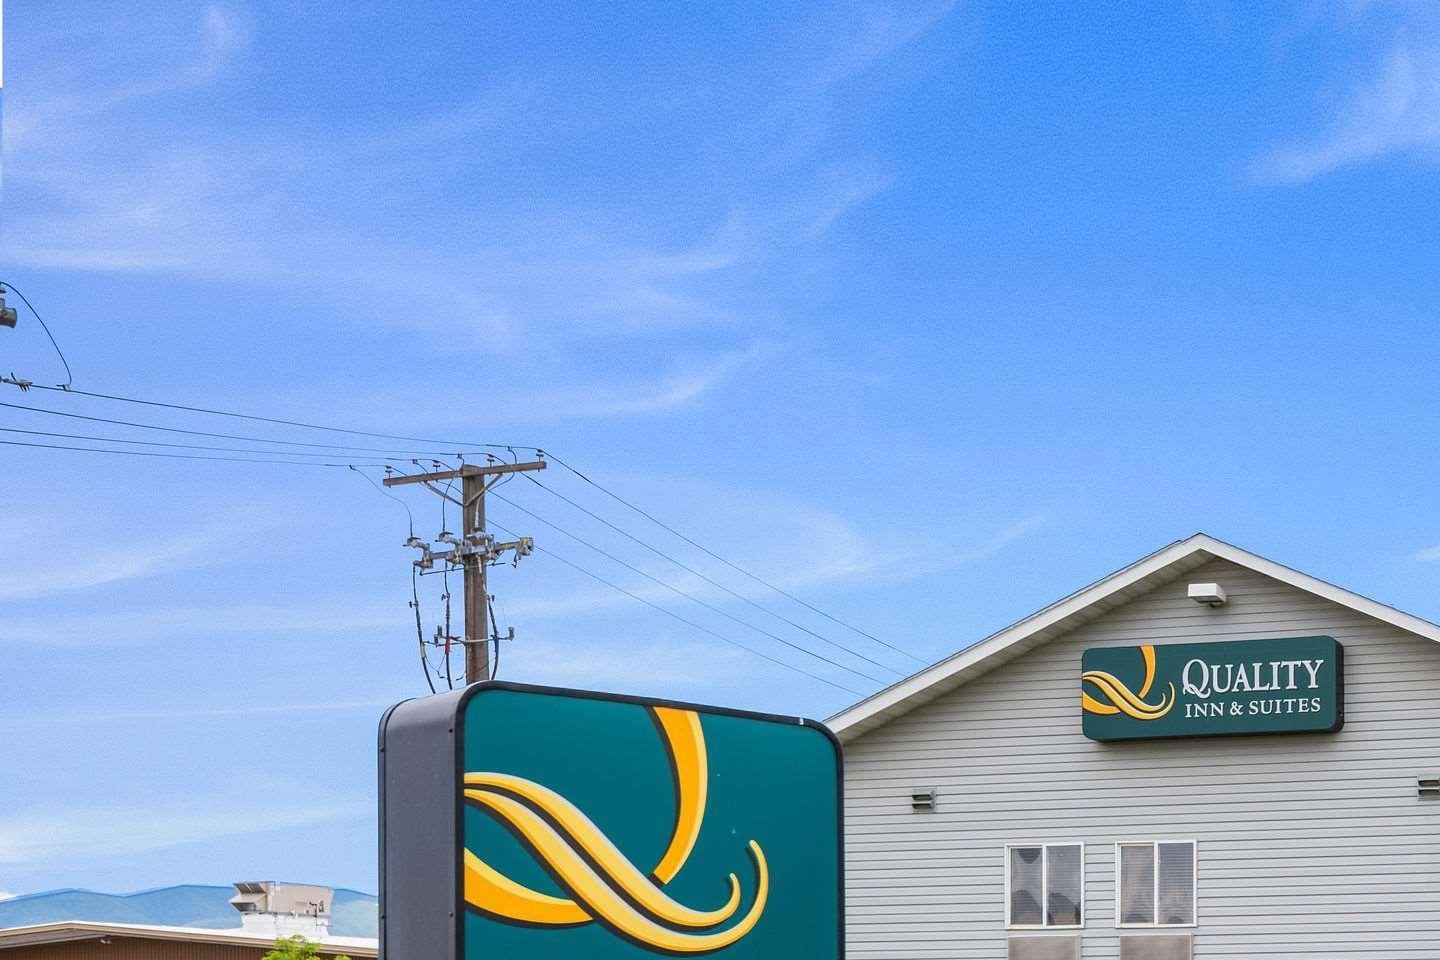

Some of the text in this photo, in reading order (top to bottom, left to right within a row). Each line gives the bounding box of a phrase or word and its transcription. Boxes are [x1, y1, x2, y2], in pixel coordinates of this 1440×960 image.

[1181, 658, 1325, 699] QUALITY
[1184, 697, 1322, 718] INN & SUITES
